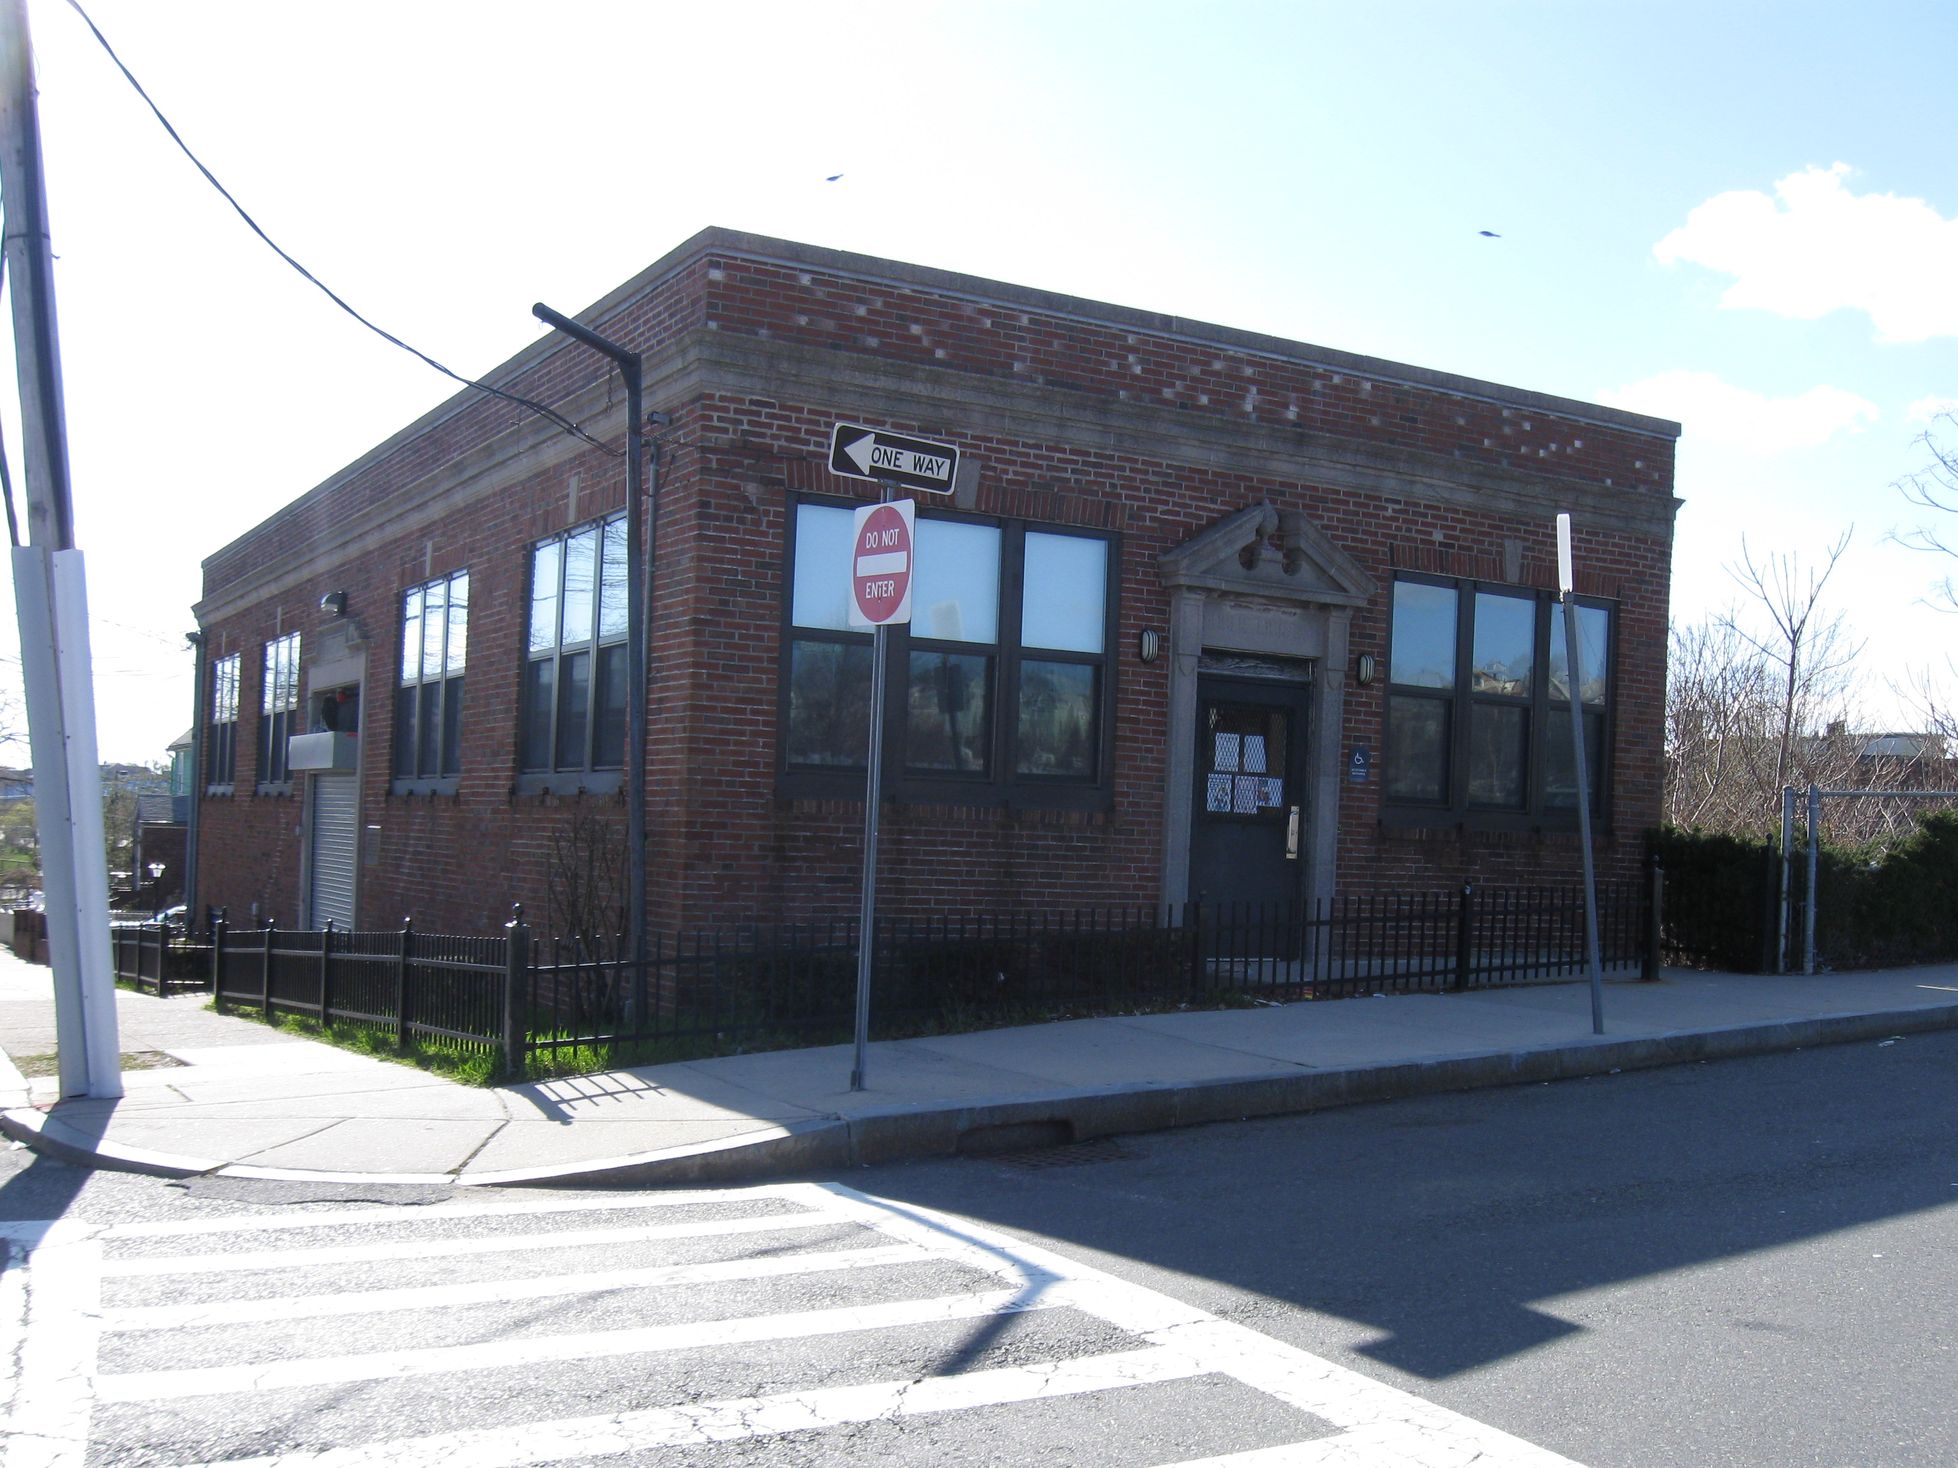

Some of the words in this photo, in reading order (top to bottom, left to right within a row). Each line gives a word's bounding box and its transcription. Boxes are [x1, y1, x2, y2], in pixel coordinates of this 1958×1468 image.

[871, 446, 904, 469] ONE
[913, 455, 945, 477] WAY
[866, 532, 878, 548] DO
[882, 528, 900, 547] NOT
[865, 580, 895, 599] ENTER
